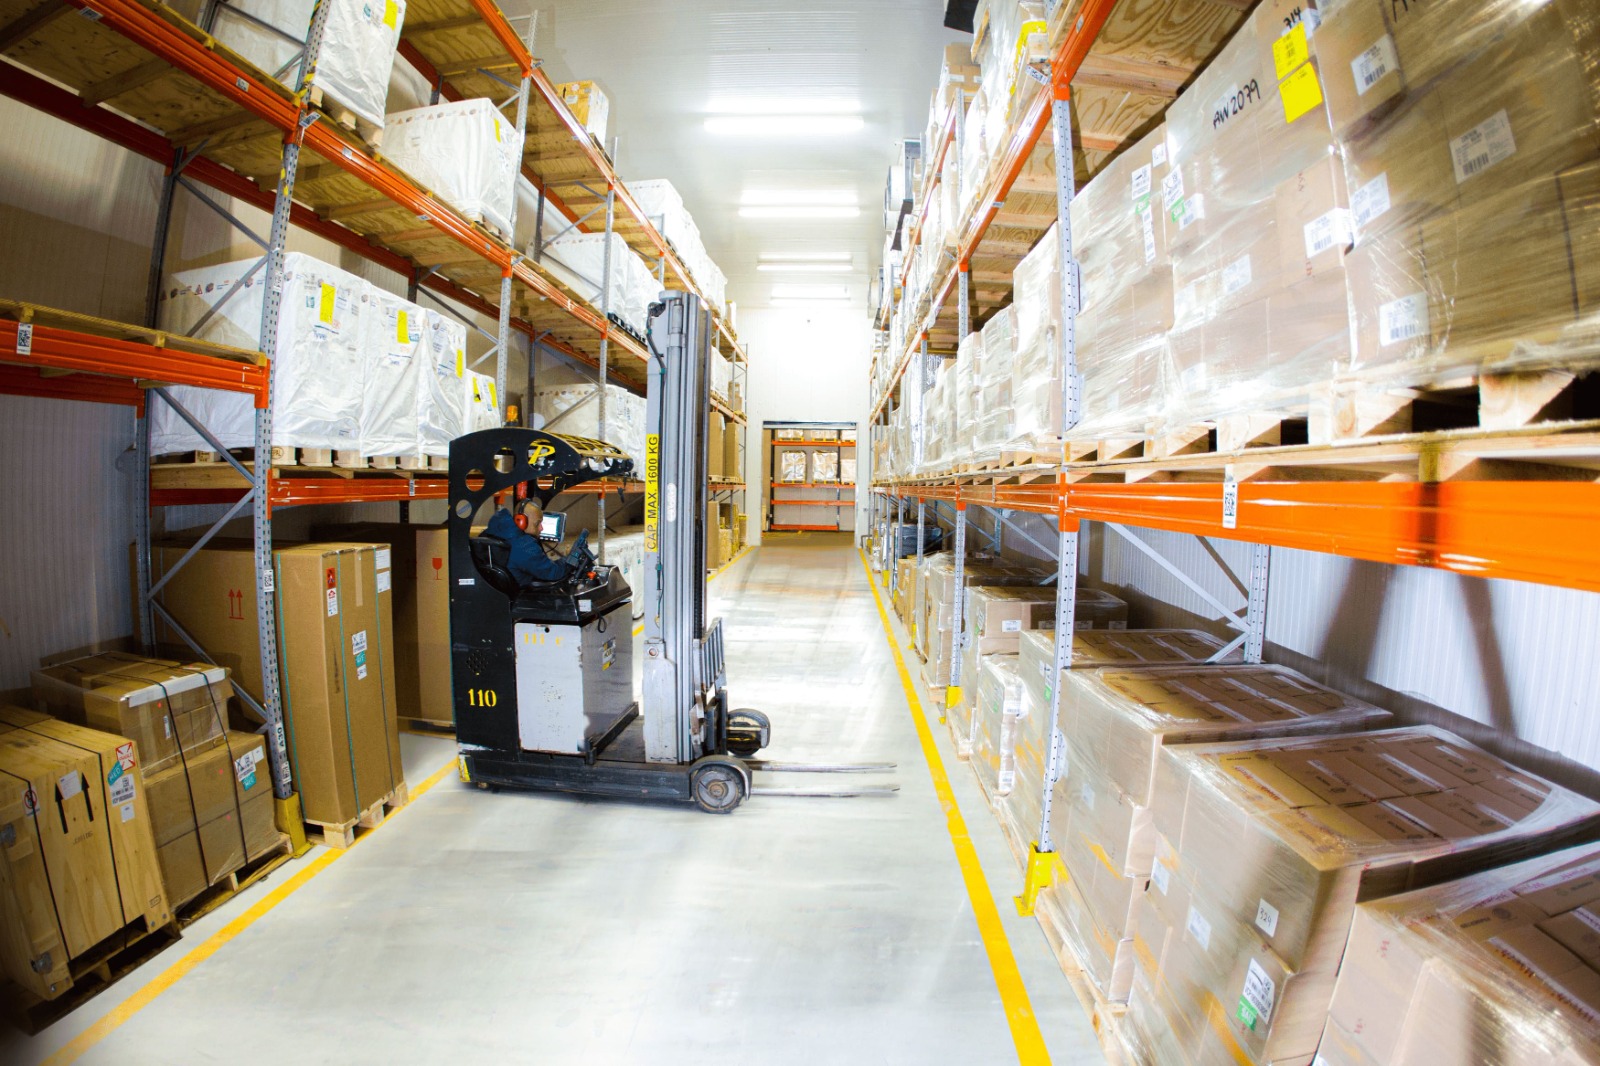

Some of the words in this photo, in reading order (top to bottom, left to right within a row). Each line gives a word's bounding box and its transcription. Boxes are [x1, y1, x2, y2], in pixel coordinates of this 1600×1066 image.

[648, 436, 657, 454] KG
[648, 457, 657, 484] 1600
[647, 488, 657, 518] MAX.
[646, 522, 656, 549] CAP.
[468, 688, 497, 707] 110
